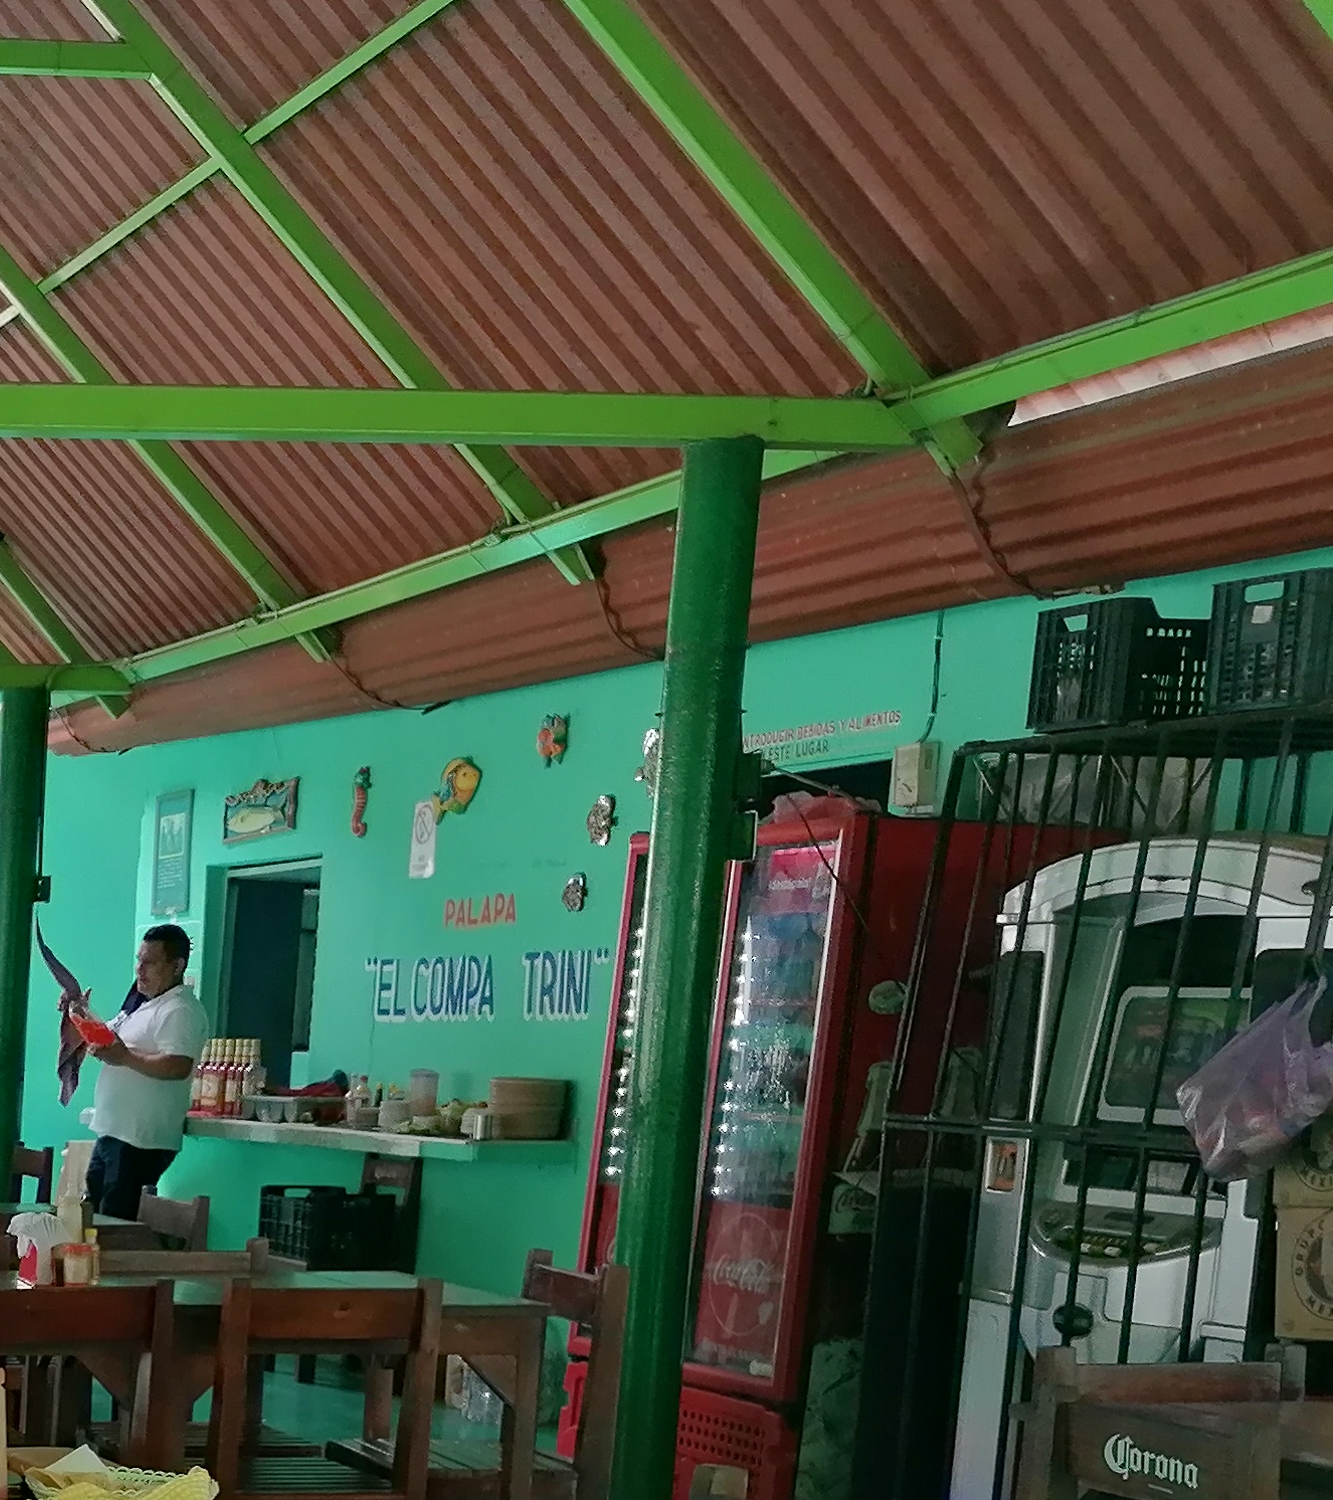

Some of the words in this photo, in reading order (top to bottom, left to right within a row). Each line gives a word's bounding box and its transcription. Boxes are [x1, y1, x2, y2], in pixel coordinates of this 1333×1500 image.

[796, 739, 829, 757] LUGAR
[443, 893, 517, 928] PALAPA
[411, 953, 495, 1023] COMPA
[1104, 1433, 1199, 1489] Corona
